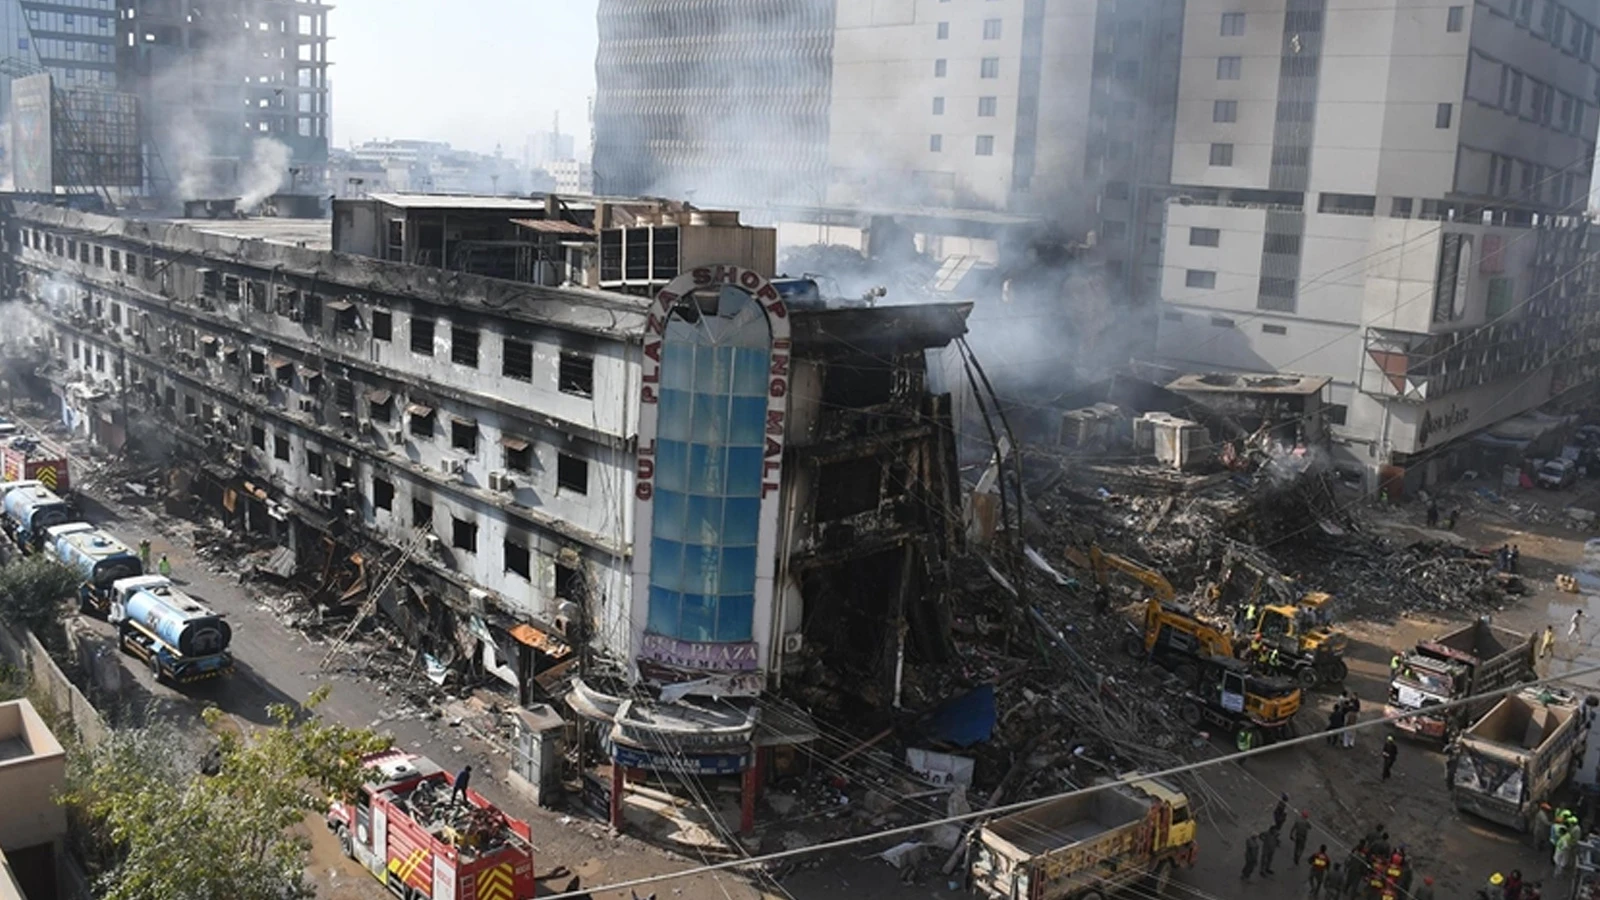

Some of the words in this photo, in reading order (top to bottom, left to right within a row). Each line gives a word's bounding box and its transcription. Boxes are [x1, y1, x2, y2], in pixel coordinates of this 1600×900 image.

[641, 289, 678, 404] PLAZA
[635, 439, 655, 502] GUL
[762, 409, 784, 500] MALL
[654, 652, 744, 670] BASEMENT
[691, 643, 757, 661] PLAZA
